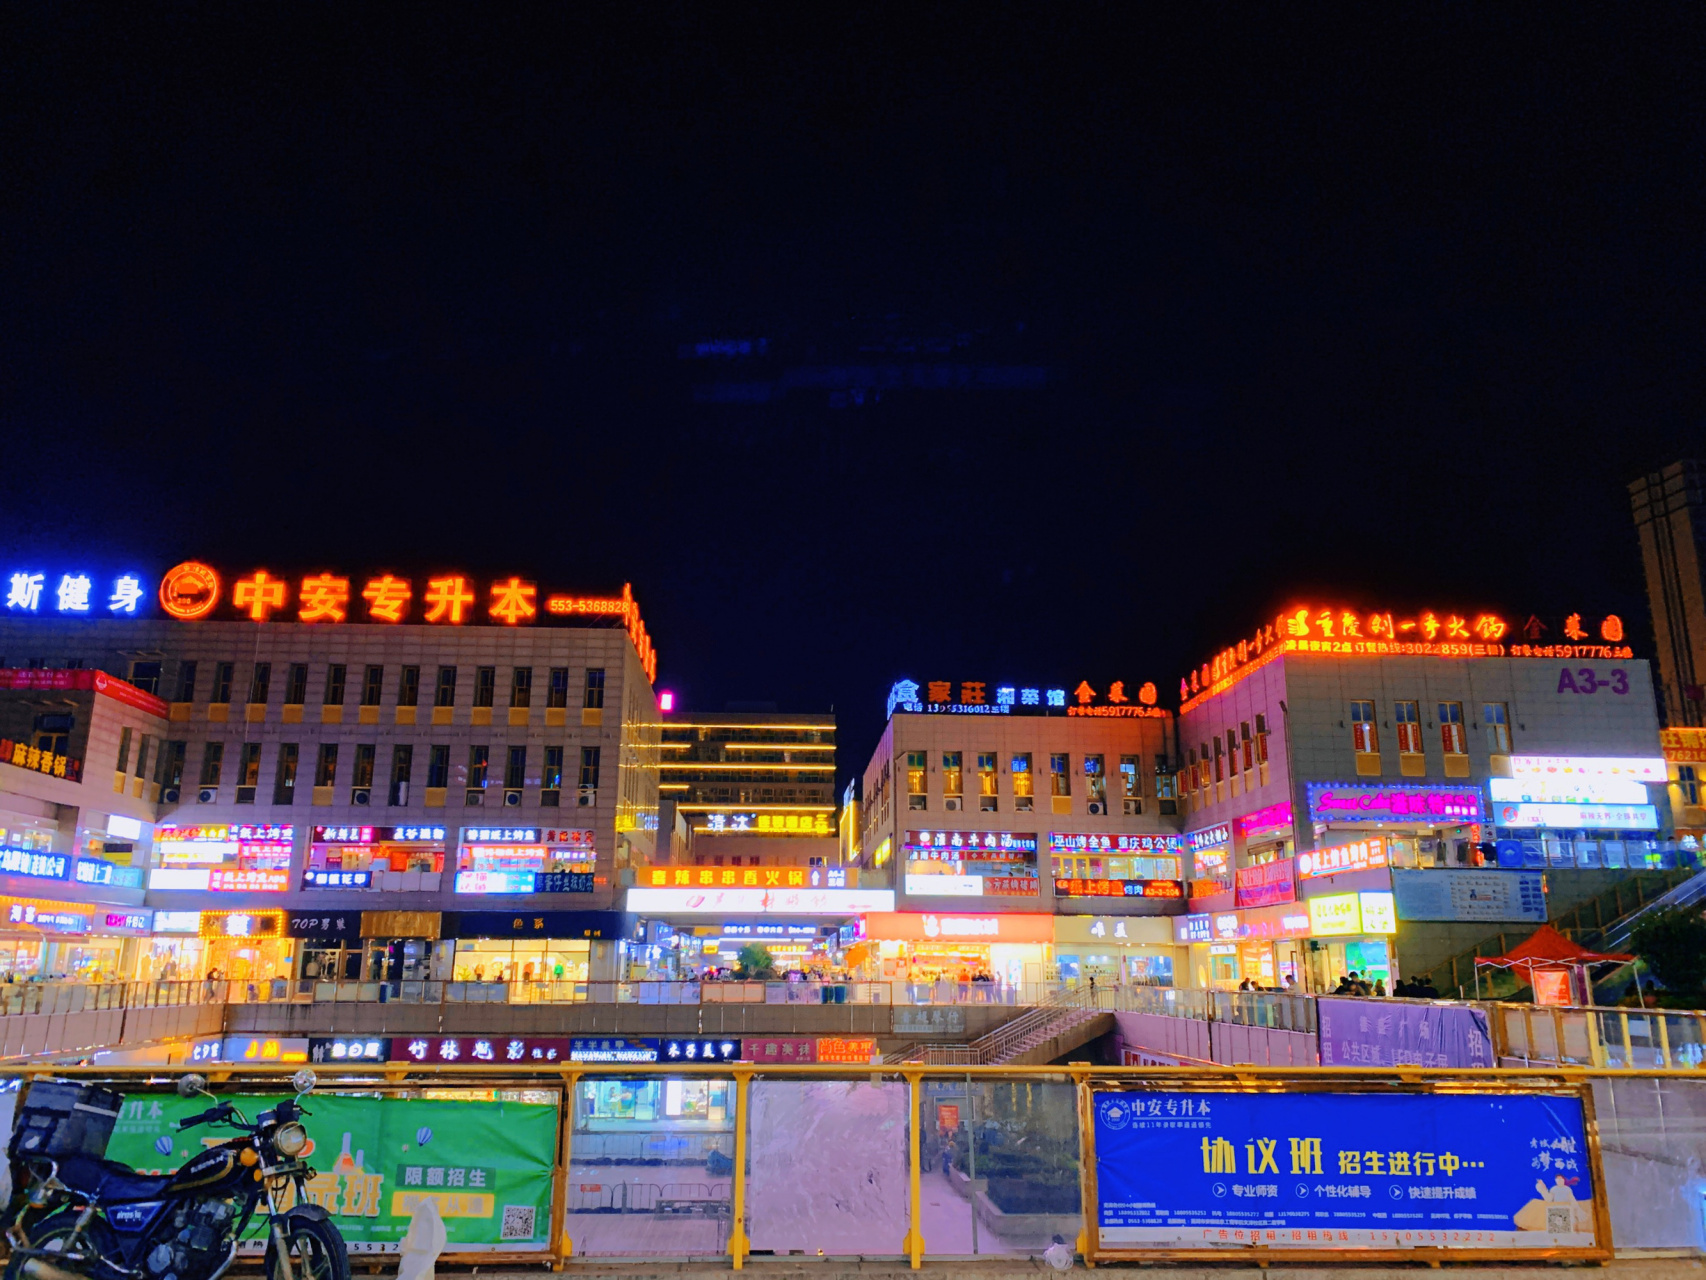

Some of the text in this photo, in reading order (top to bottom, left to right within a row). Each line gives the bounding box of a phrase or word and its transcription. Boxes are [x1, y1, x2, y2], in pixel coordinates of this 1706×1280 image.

[7, 572, 144, 612] 斯健身
[234, 572, 536, 623] 中安专升本
[1557, 667, 1630, 695] A3-3
[934, 832, 1013, 848] 淮南牛肉汤
[1054, 834, 1111, 849] 巫山烤全鱼
[1117, 836, 1178, 850] 重庆鸡公煲
[291, 918, 319, 931] TOP
[1131, 1098, 1212, 1117] 中安专升本
[405, 1166, 488, 1188] 限额招生
[1232, 1184, 1279, 1198] 专业师资
[1314, 1184, 1372, 1199] 个性化辅导
[1408, 1186, 1478, 1200] 快速提升成绩
